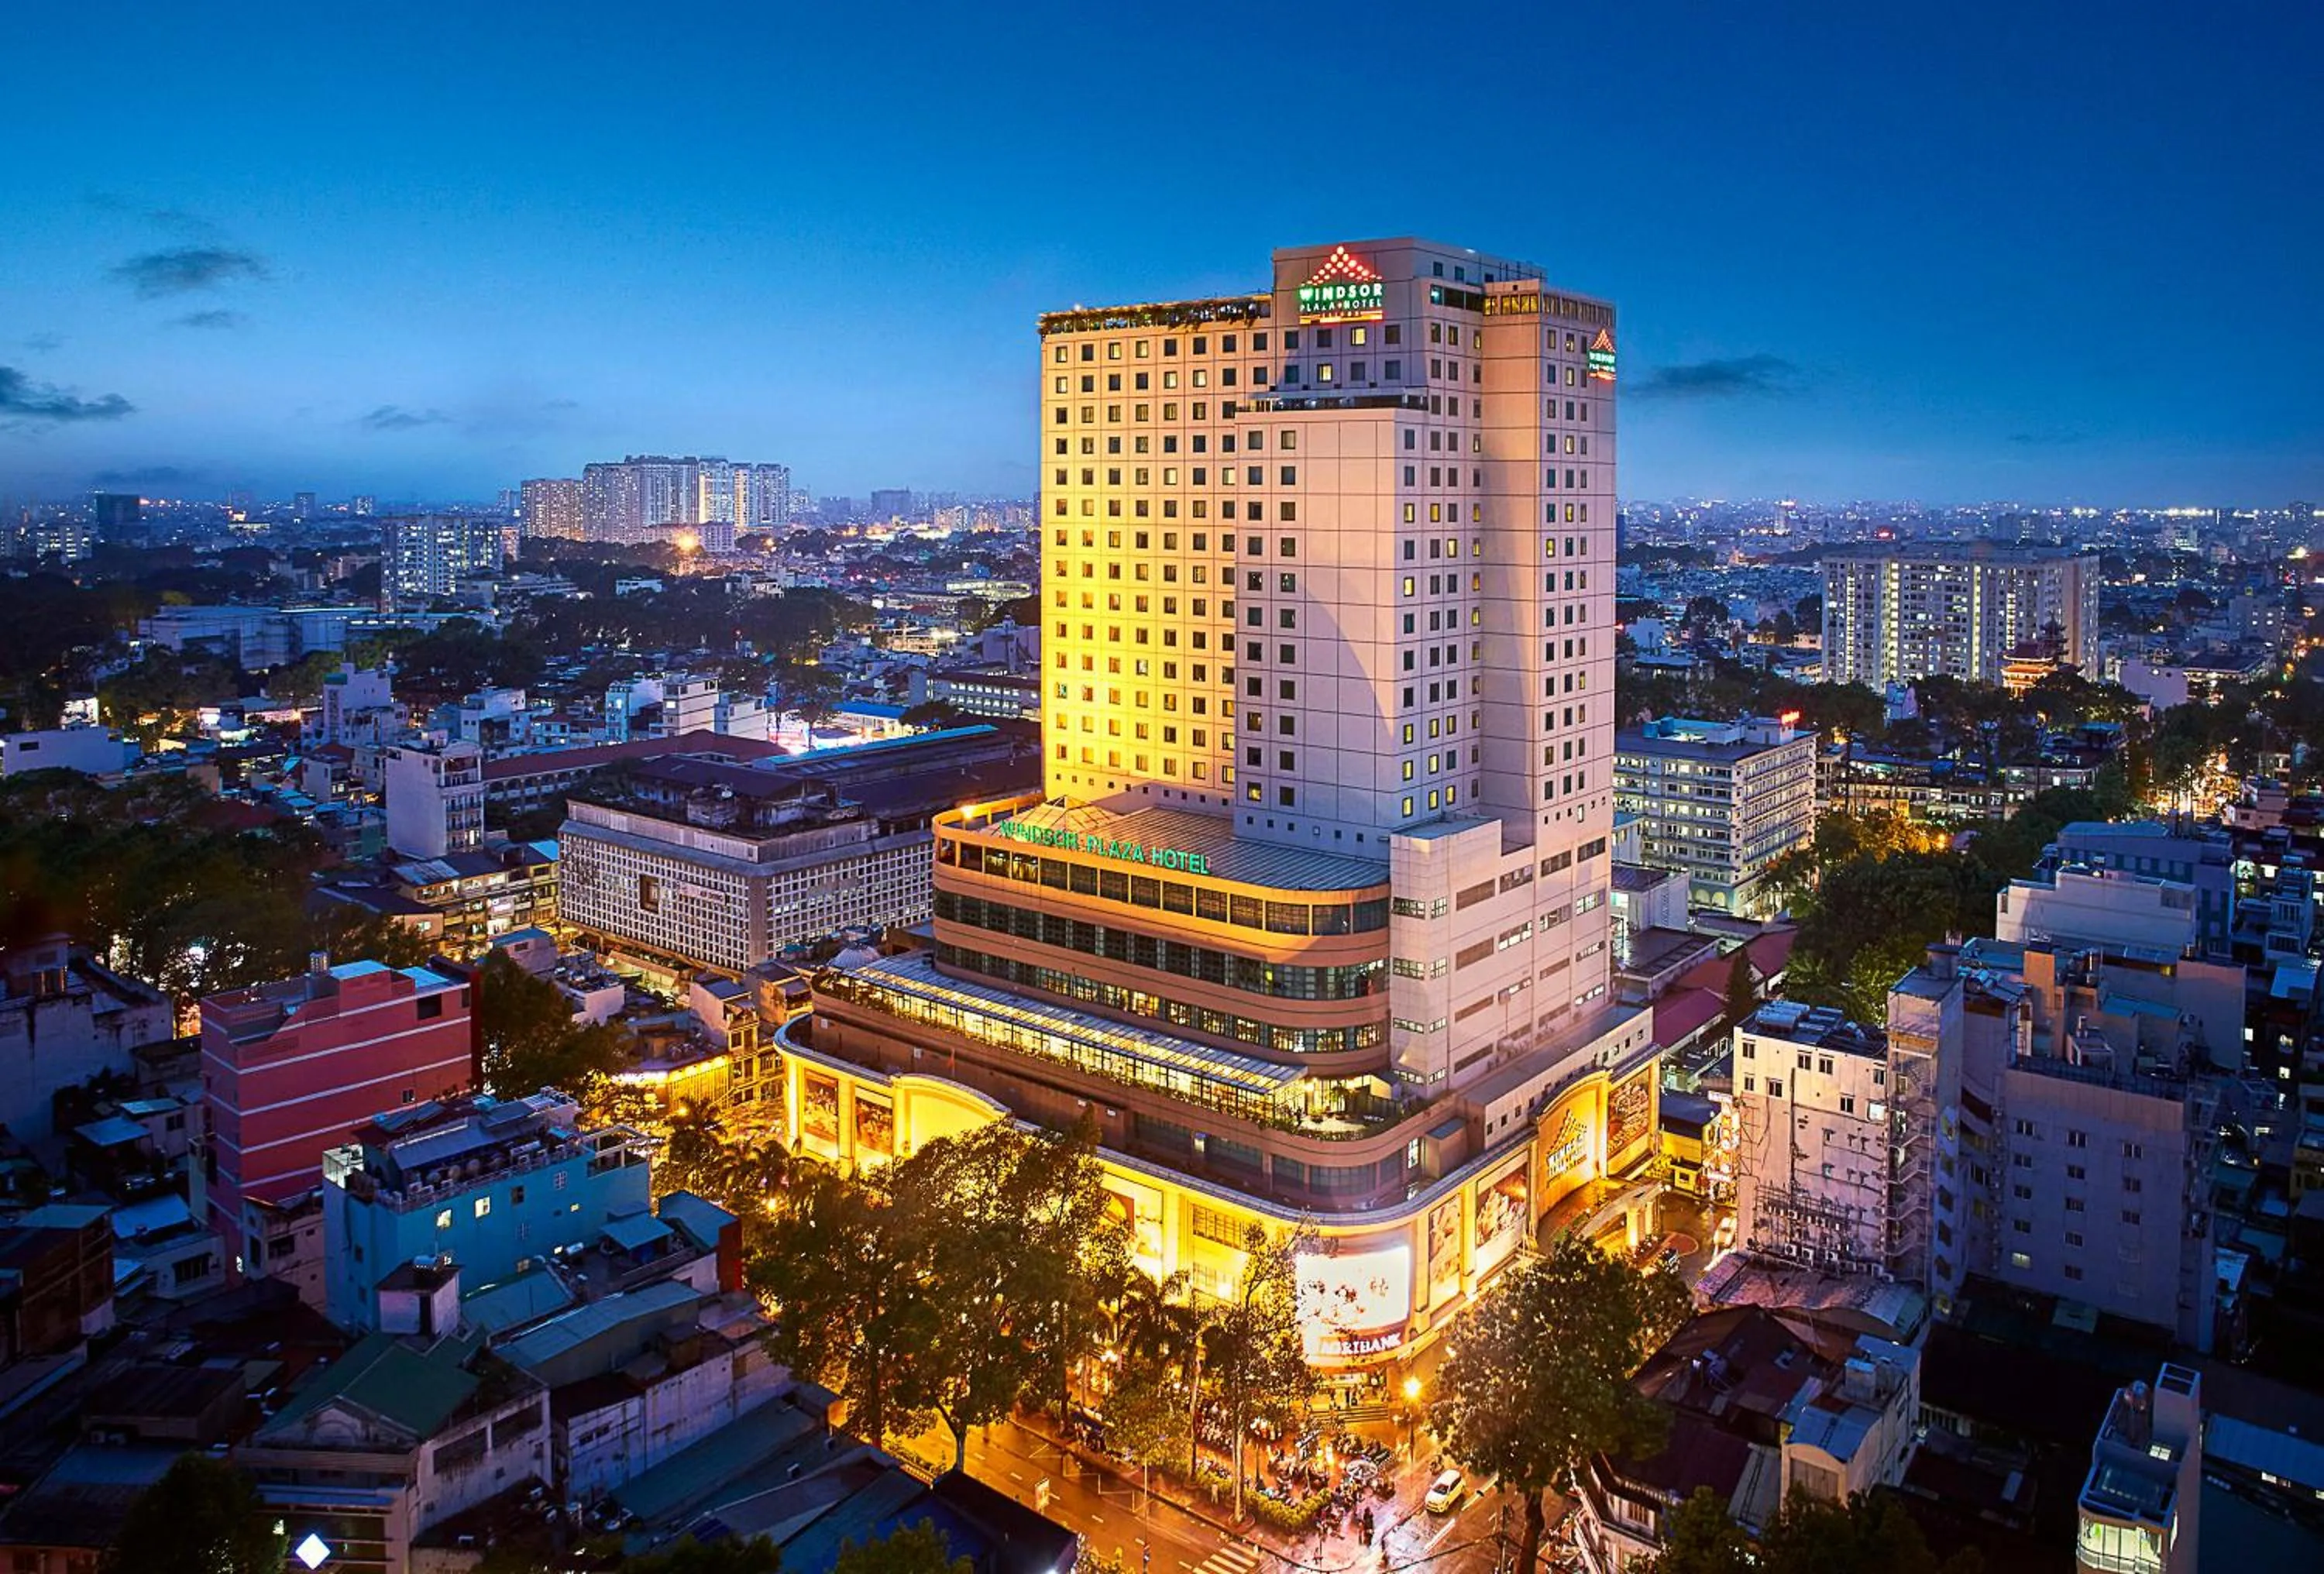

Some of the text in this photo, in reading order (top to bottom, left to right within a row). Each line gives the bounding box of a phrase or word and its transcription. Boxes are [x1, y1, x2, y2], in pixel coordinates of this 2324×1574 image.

[1300, 284, 1382, 301] WINDSOR
[999, 820, 1211, 874] WINDSOR PLAZA HOTEL
